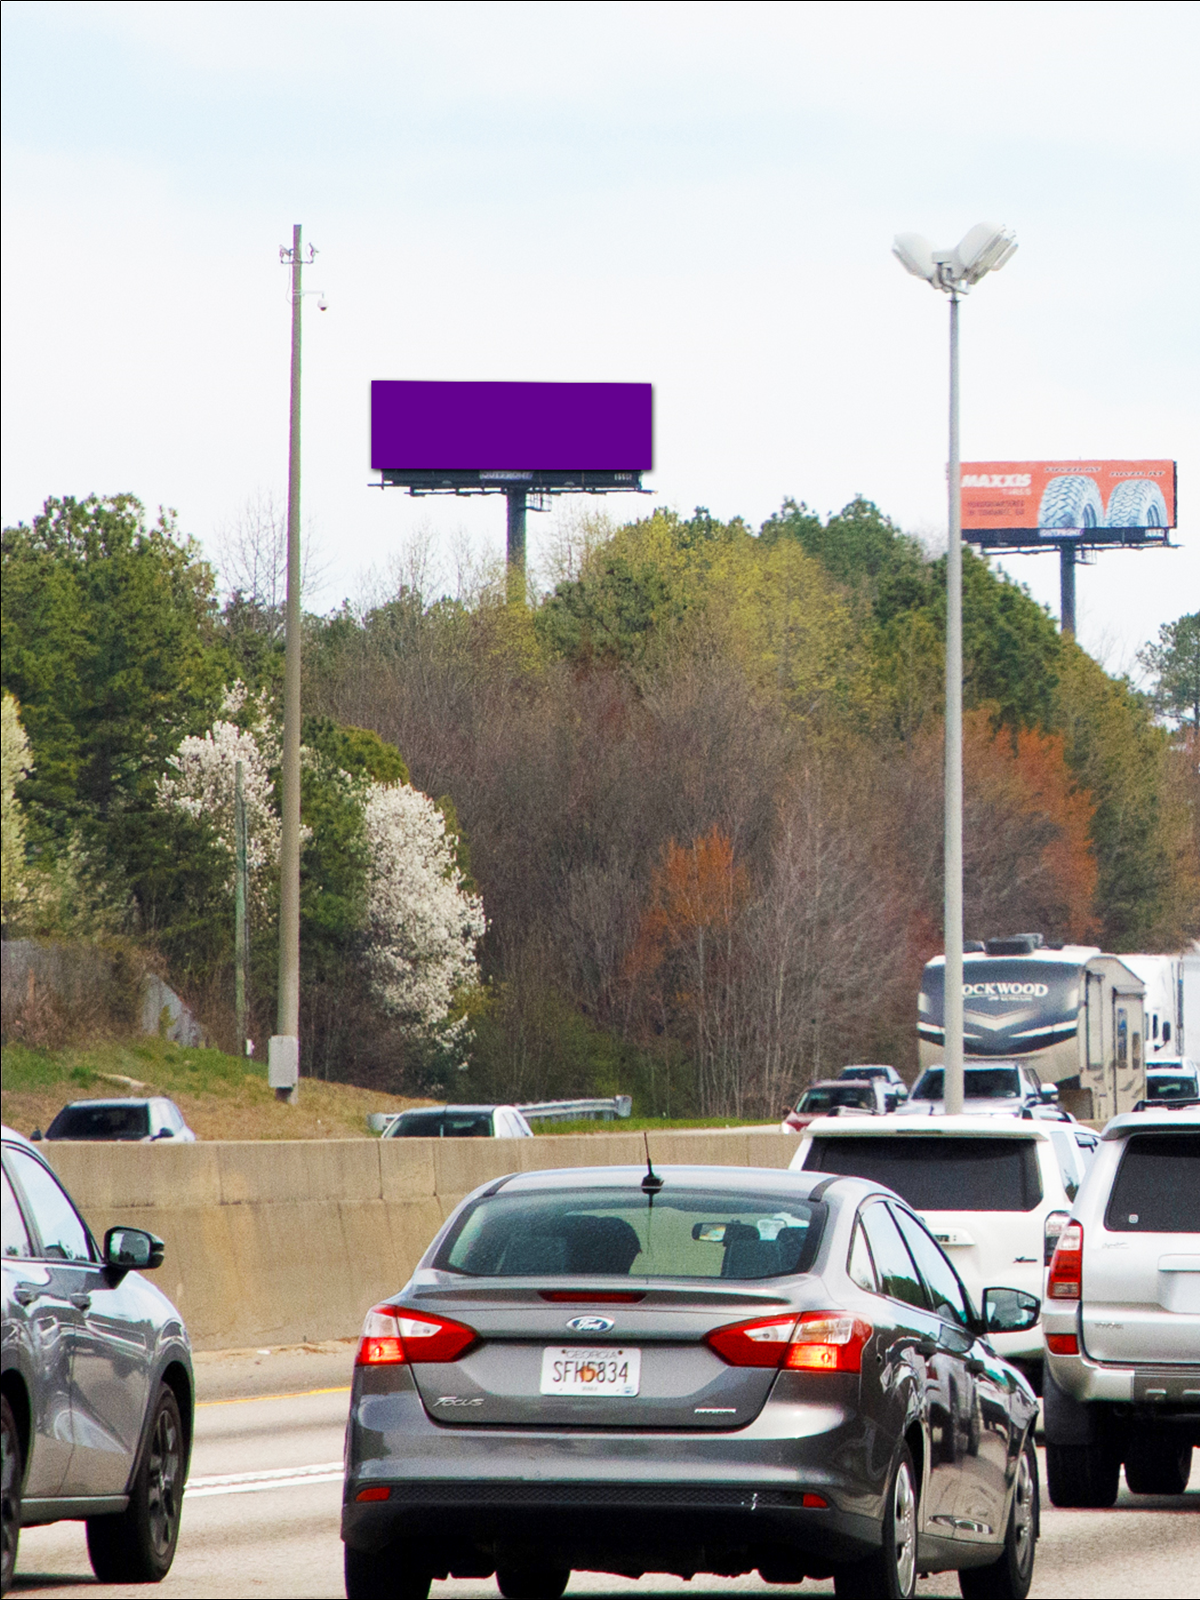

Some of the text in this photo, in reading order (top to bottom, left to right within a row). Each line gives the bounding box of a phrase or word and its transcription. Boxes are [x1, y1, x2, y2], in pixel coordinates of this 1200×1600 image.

[960, 474, 1031, 487] MAXXIS
[962, 982, 1048, 997] OCKWOOD
[575, 1318, 604, 1331] Ford
[566, 1350, 618, 1359] GEORGIA
[553, 1360, 628, 1383] SFH5834
